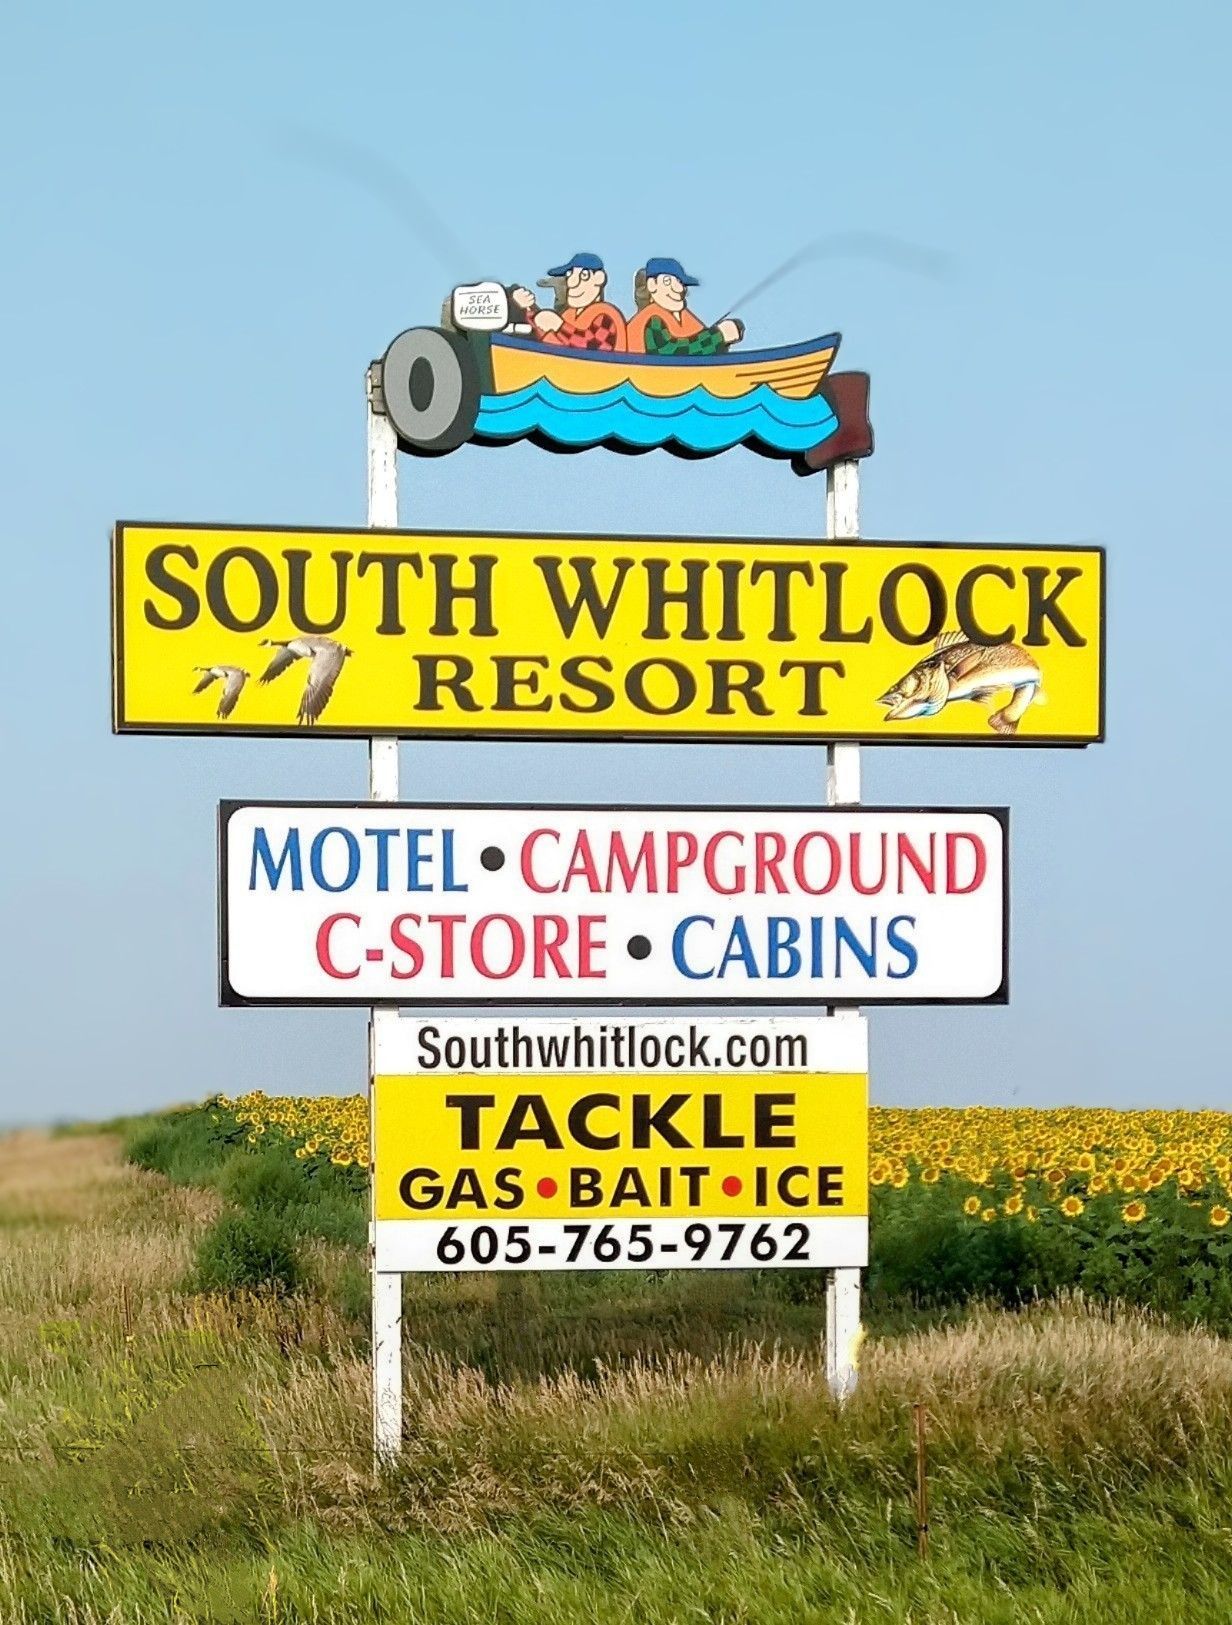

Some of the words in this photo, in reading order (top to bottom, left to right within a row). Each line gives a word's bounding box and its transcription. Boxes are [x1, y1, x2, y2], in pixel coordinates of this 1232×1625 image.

[460, 304, 501, 315] HORSE
[468, 294, 491, 304] SEA
[144, 543, 499, 636] SOUTH
[533, 555, 1088, 648] WHITLOCK
[412, 654, 846, 717] RESORT
[249, 826, 469, 893] MOTEL
[520, 828, 988, 896] CAMPGROUND
[315, 912, 608, 980] C-STORE
[671, 914, 919, 980] CABINS
[417, 1025, 809, 1070] Southwhitlock.com
[445, 1092, 797, 1151] TACKLE
[398, 1167, 525, 1210] GAS
[569, 1166, 710, 1208] BAIT
[755, 1165, 844, 1207] ICE
[436, 1222, 811, 1265] 605-765-9762
